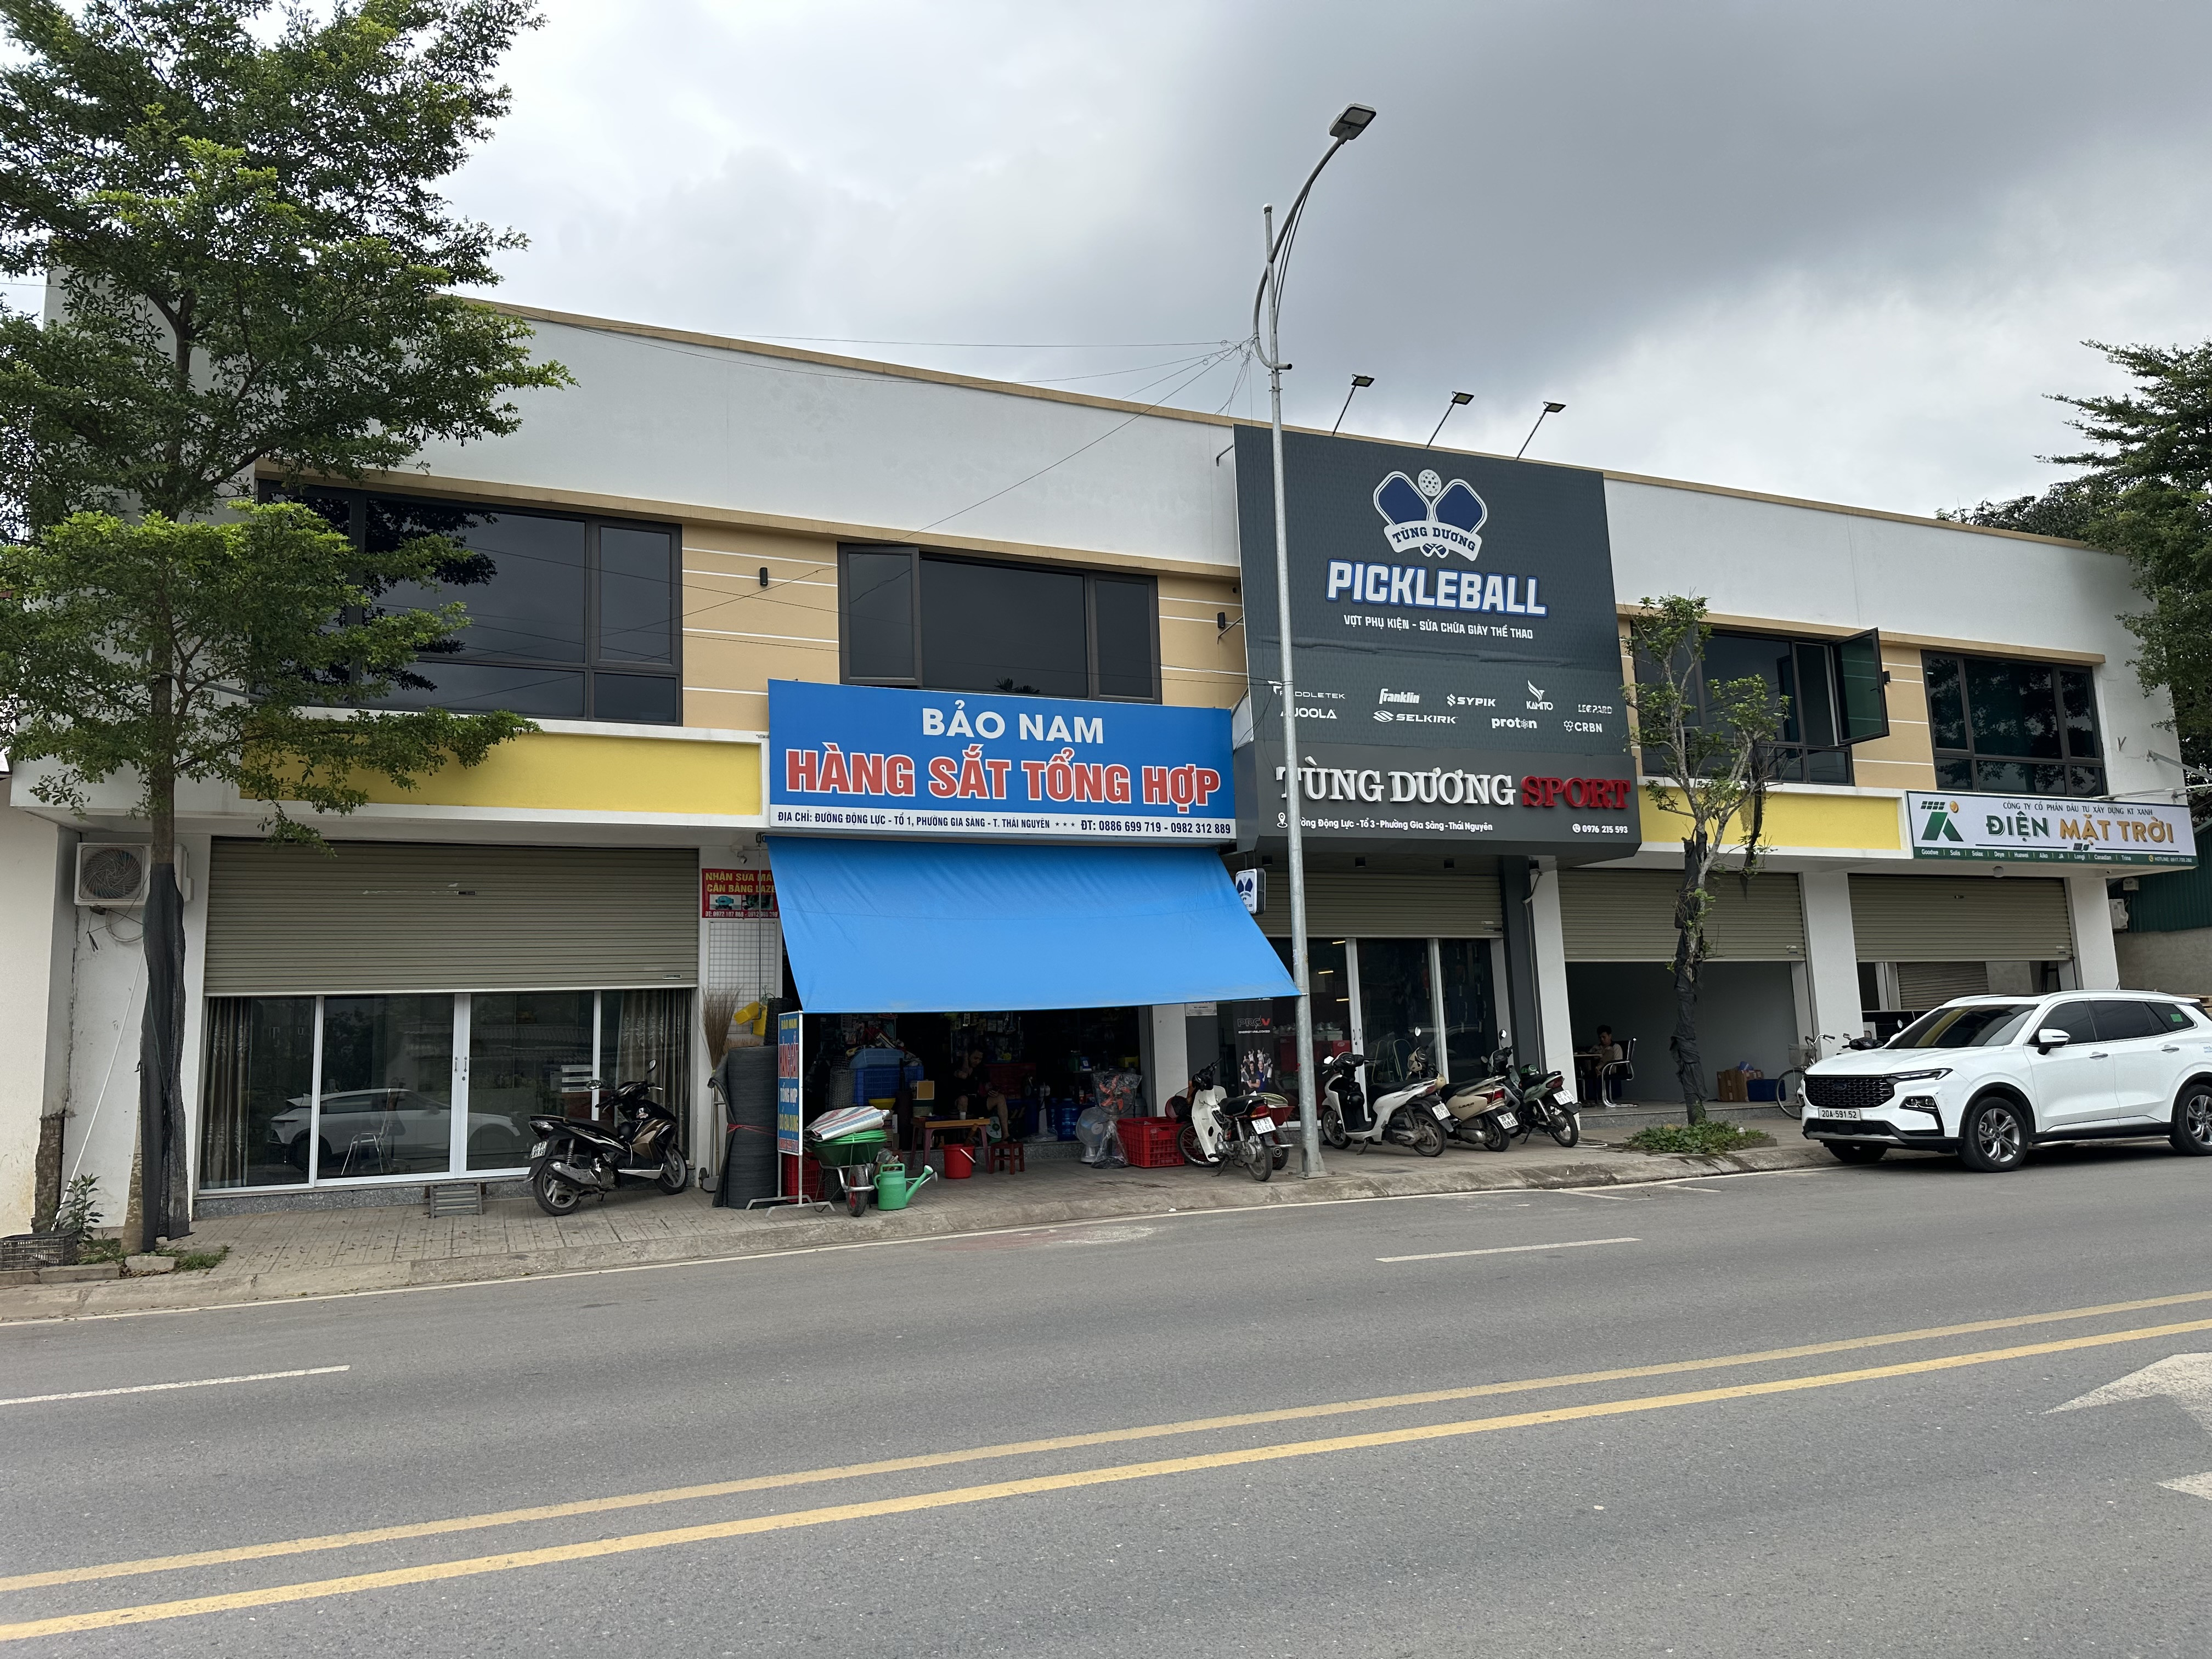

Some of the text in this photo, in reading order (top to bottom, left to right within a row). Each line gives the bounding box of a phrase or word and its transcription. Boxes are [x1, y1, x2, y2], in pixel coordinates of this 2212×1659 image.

[1392, 527, 1476, 551] TÙNG DƯƠNG
[1327, 560, 1547, 615] PICKLEBALL
[1344, 614, 1362, 628] VỢT
[1365, 616, 1385, 630] PHỤ
[1387, 617, 1409, 631] KIỆN
[1419, 619, 1438, 631] SỬA
[1441, 622, 1465, 634] CHỮA
[1468, 623, 1488, 636] GIÀY
[1491, 624, 1508, 637] THỂ
[1510, 628, 1533, 639] THAO
[1279, 691, 1345, 699] DDLETEK
[1457, 697, 1496, 707] SYPIK
[1526, 701, 1553, 710] KAMITO
[1295, 707, 1337, 719] JOOLA
[1396, 714, 1457, 724] SELKIRK
[922, 700, 1103, 744] BẢO NAM
[1492, 717, 1537, 729] proton
[1574, 722, 1602, 733] CRBN
[786, 741, 1221, 814] HÀNG SẮT TỔNG HỢP
[1387, 767, 1516, 806] DƯƠNG
[1521, 775, 1631, 809] SPORT
[2003, 800, 2020, 810] CÔNG
[2034, 801, 2043, 811] CỔ
[2046, 802, 2063, 811] PHẦN
[2066, 803, 2079, 812] ĐẦU
[2093, 804, 2104, 814] XÂY
[2108, 806, 2124, 815] DỰNG
[778, 811, 792, 823] ĐỊA
[795, 810, 812, 822] CHỈ:
[815, 811, 843, 823] ĐƯỜNG
[845, 812, 868, 825] ĐỘNG
[871, 814, 885, 826] LỰC
[894, 812, 904, 825] TỔ
[907, 817, 913, 827] 1,
[916, 815, 948, 826] PHƯỜNG
[951, 817, 963, 827] GIA
[966, 816, 985, 827] SÀNG
[993, 819, 1000, 827] T.
[1002, 816, 1018, 828] THÁI
[1021, 817, 1050, 828] NGUYÊN
[1081, 820, 1096, 831] ĐT:
[1099, 821, 1122, 831] 0886
[1125, 821, 1142, 832] 699
[1144, 822, 1161, 832] 719
[1171, 822, 1193, 833] 0982
[1195, 823, 1212, 833] 312
[1215, 823, 1231, 834] 889
[1300, 817, 1316, 829] ờng
[1318, 819, 1339, 829] Động
[1341, 819, 1355, 830] Lực
[1410, 820, 1424, 829] Gia
[1465, 822, 1493, 833] Nguyên
[1986, 811, 2174, 845] ĐIỆN MẶT TRỜI
[1582, 825, 1628, 834] 0976 215 593
[706, 871, 732, 882] NHẬN
[757, 872, 772, 882] MÁ
[707, 883, 776, 893] CÂN BẰNG LAZE
